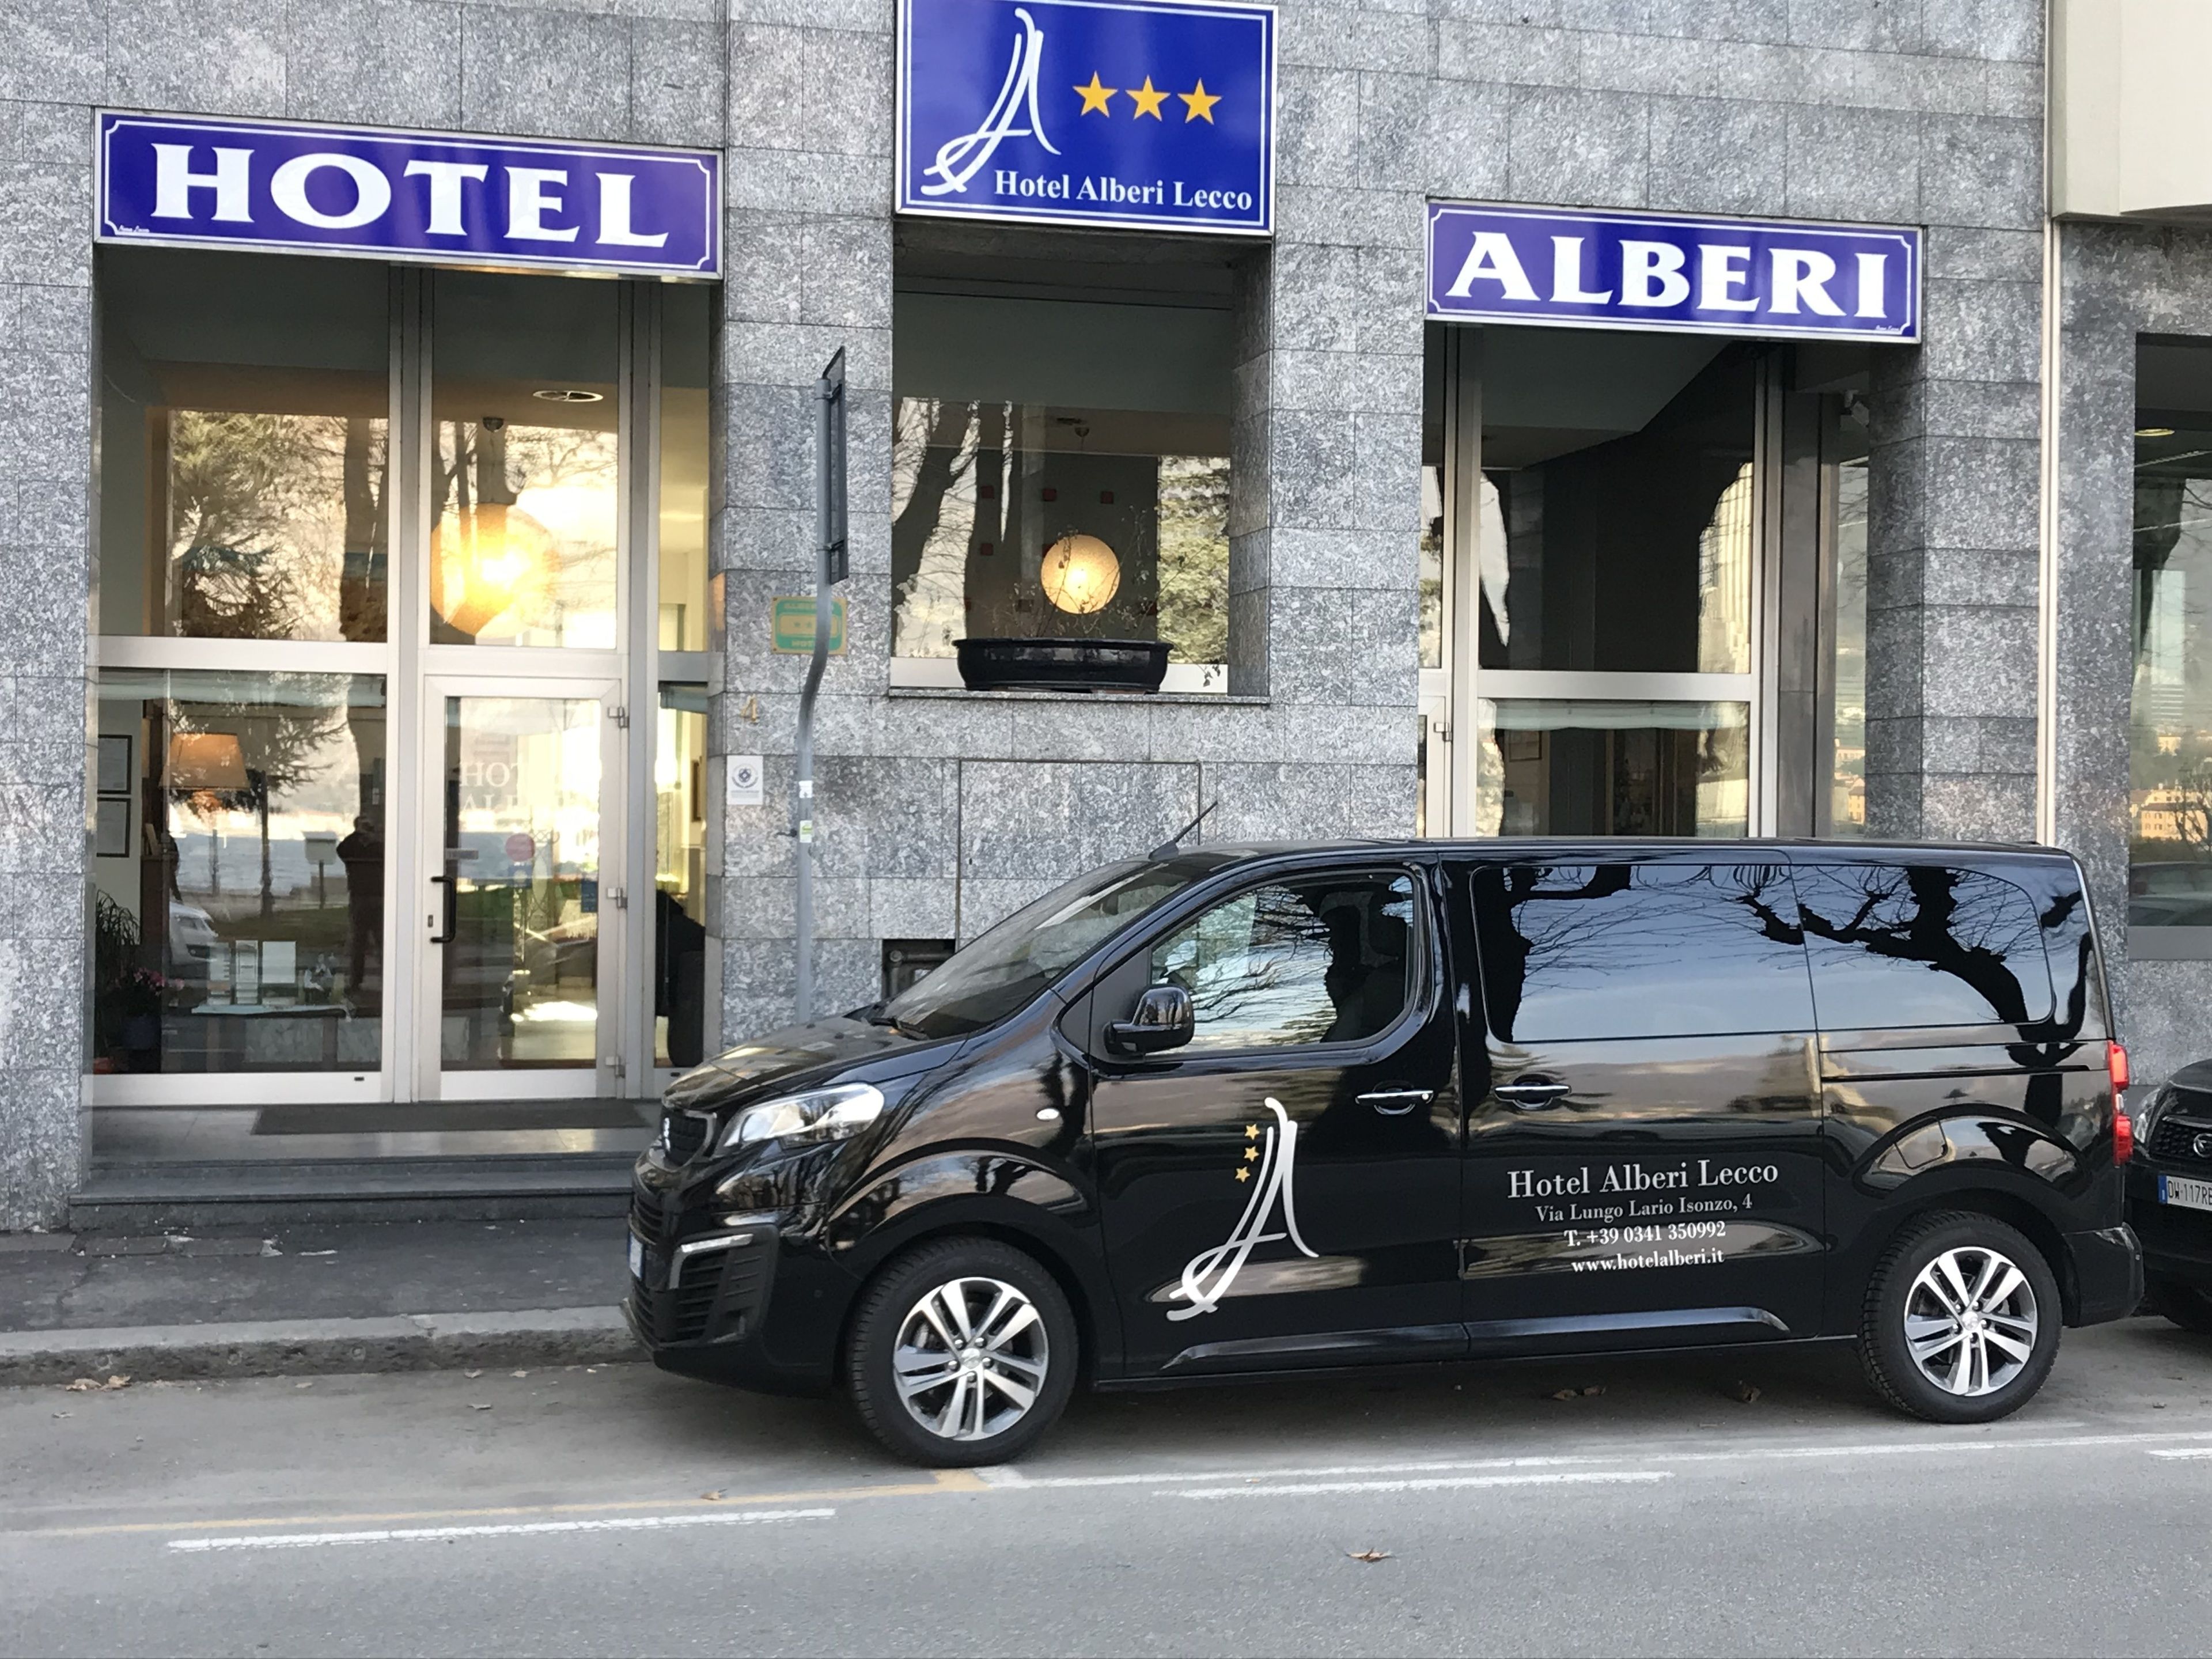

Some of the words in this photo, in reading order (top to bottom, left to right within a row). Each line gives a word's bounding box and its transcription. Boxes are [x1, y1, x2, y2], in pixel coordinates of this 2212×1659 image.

[150, 143, 669, 248] HOTEL
[995, 169, 1070, 199] Hotel
[1076, 176, 1164, 205] Alberi
[1174, 181, 1252, 210] Lecco
[1444, 231, 1889, 319] ALBERI
[1507, 1166, 1590, 1198] Hotel
[1599, 1162, 1688, 1192] Alberi
[1697, 1159, 1778, 1186] Lecco
[1535, 1205, 1564, 1222] Via
[1570, 1203, 1623, 1224] Lungo
[1628, 1199, 1673, 1217] Lario
[1679, 1196, 1738, 1213] Isonzo,
[1742, 1193, 1753, 1209] 4
[1563, 1229, 1581, 1247] T.
[1586, 1228, 1619, 1245] +39
[1623, 1225, 1661, 1243] 0341
[1668, 1221, 1726, 1240] 350992
[1571, 1247, 1725, 1272] www.hotelalberi.it
